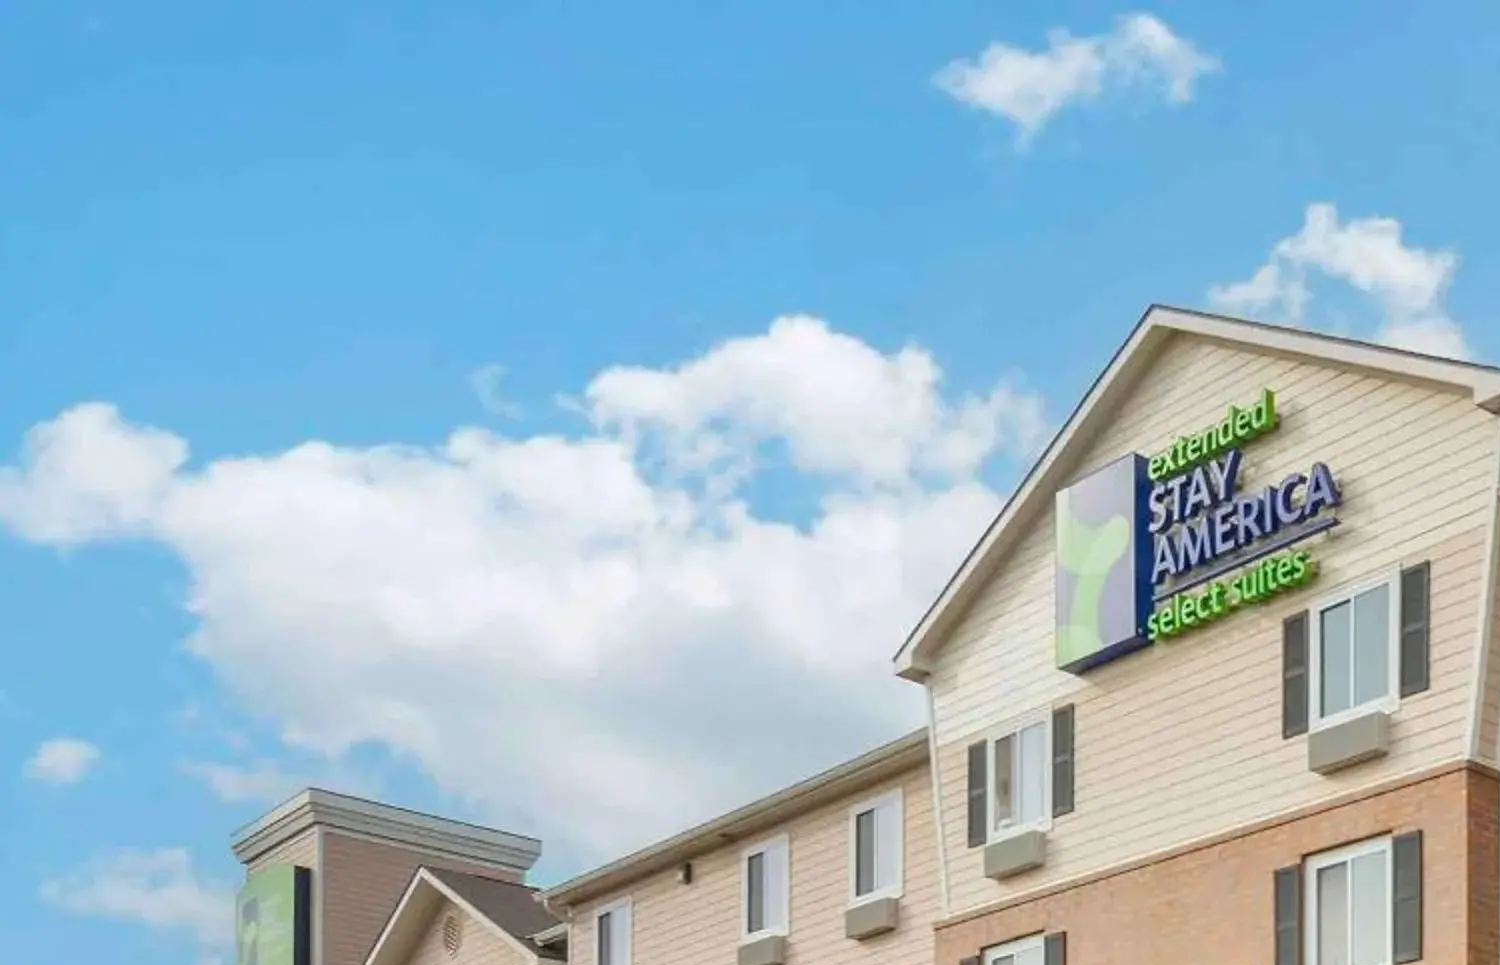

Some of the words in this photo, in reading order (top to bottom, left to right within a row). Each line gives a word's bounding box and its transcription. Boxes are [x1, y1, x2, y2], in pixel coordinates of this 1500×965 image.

[1148, 387, 1276, 479] extended
[1149, 449, 1244, 534] STAY
[1150, 461, 1341, 583] AMERICA
[1148, 582, 1228, 641] select
[1231, 550, 1316, 606] suites
